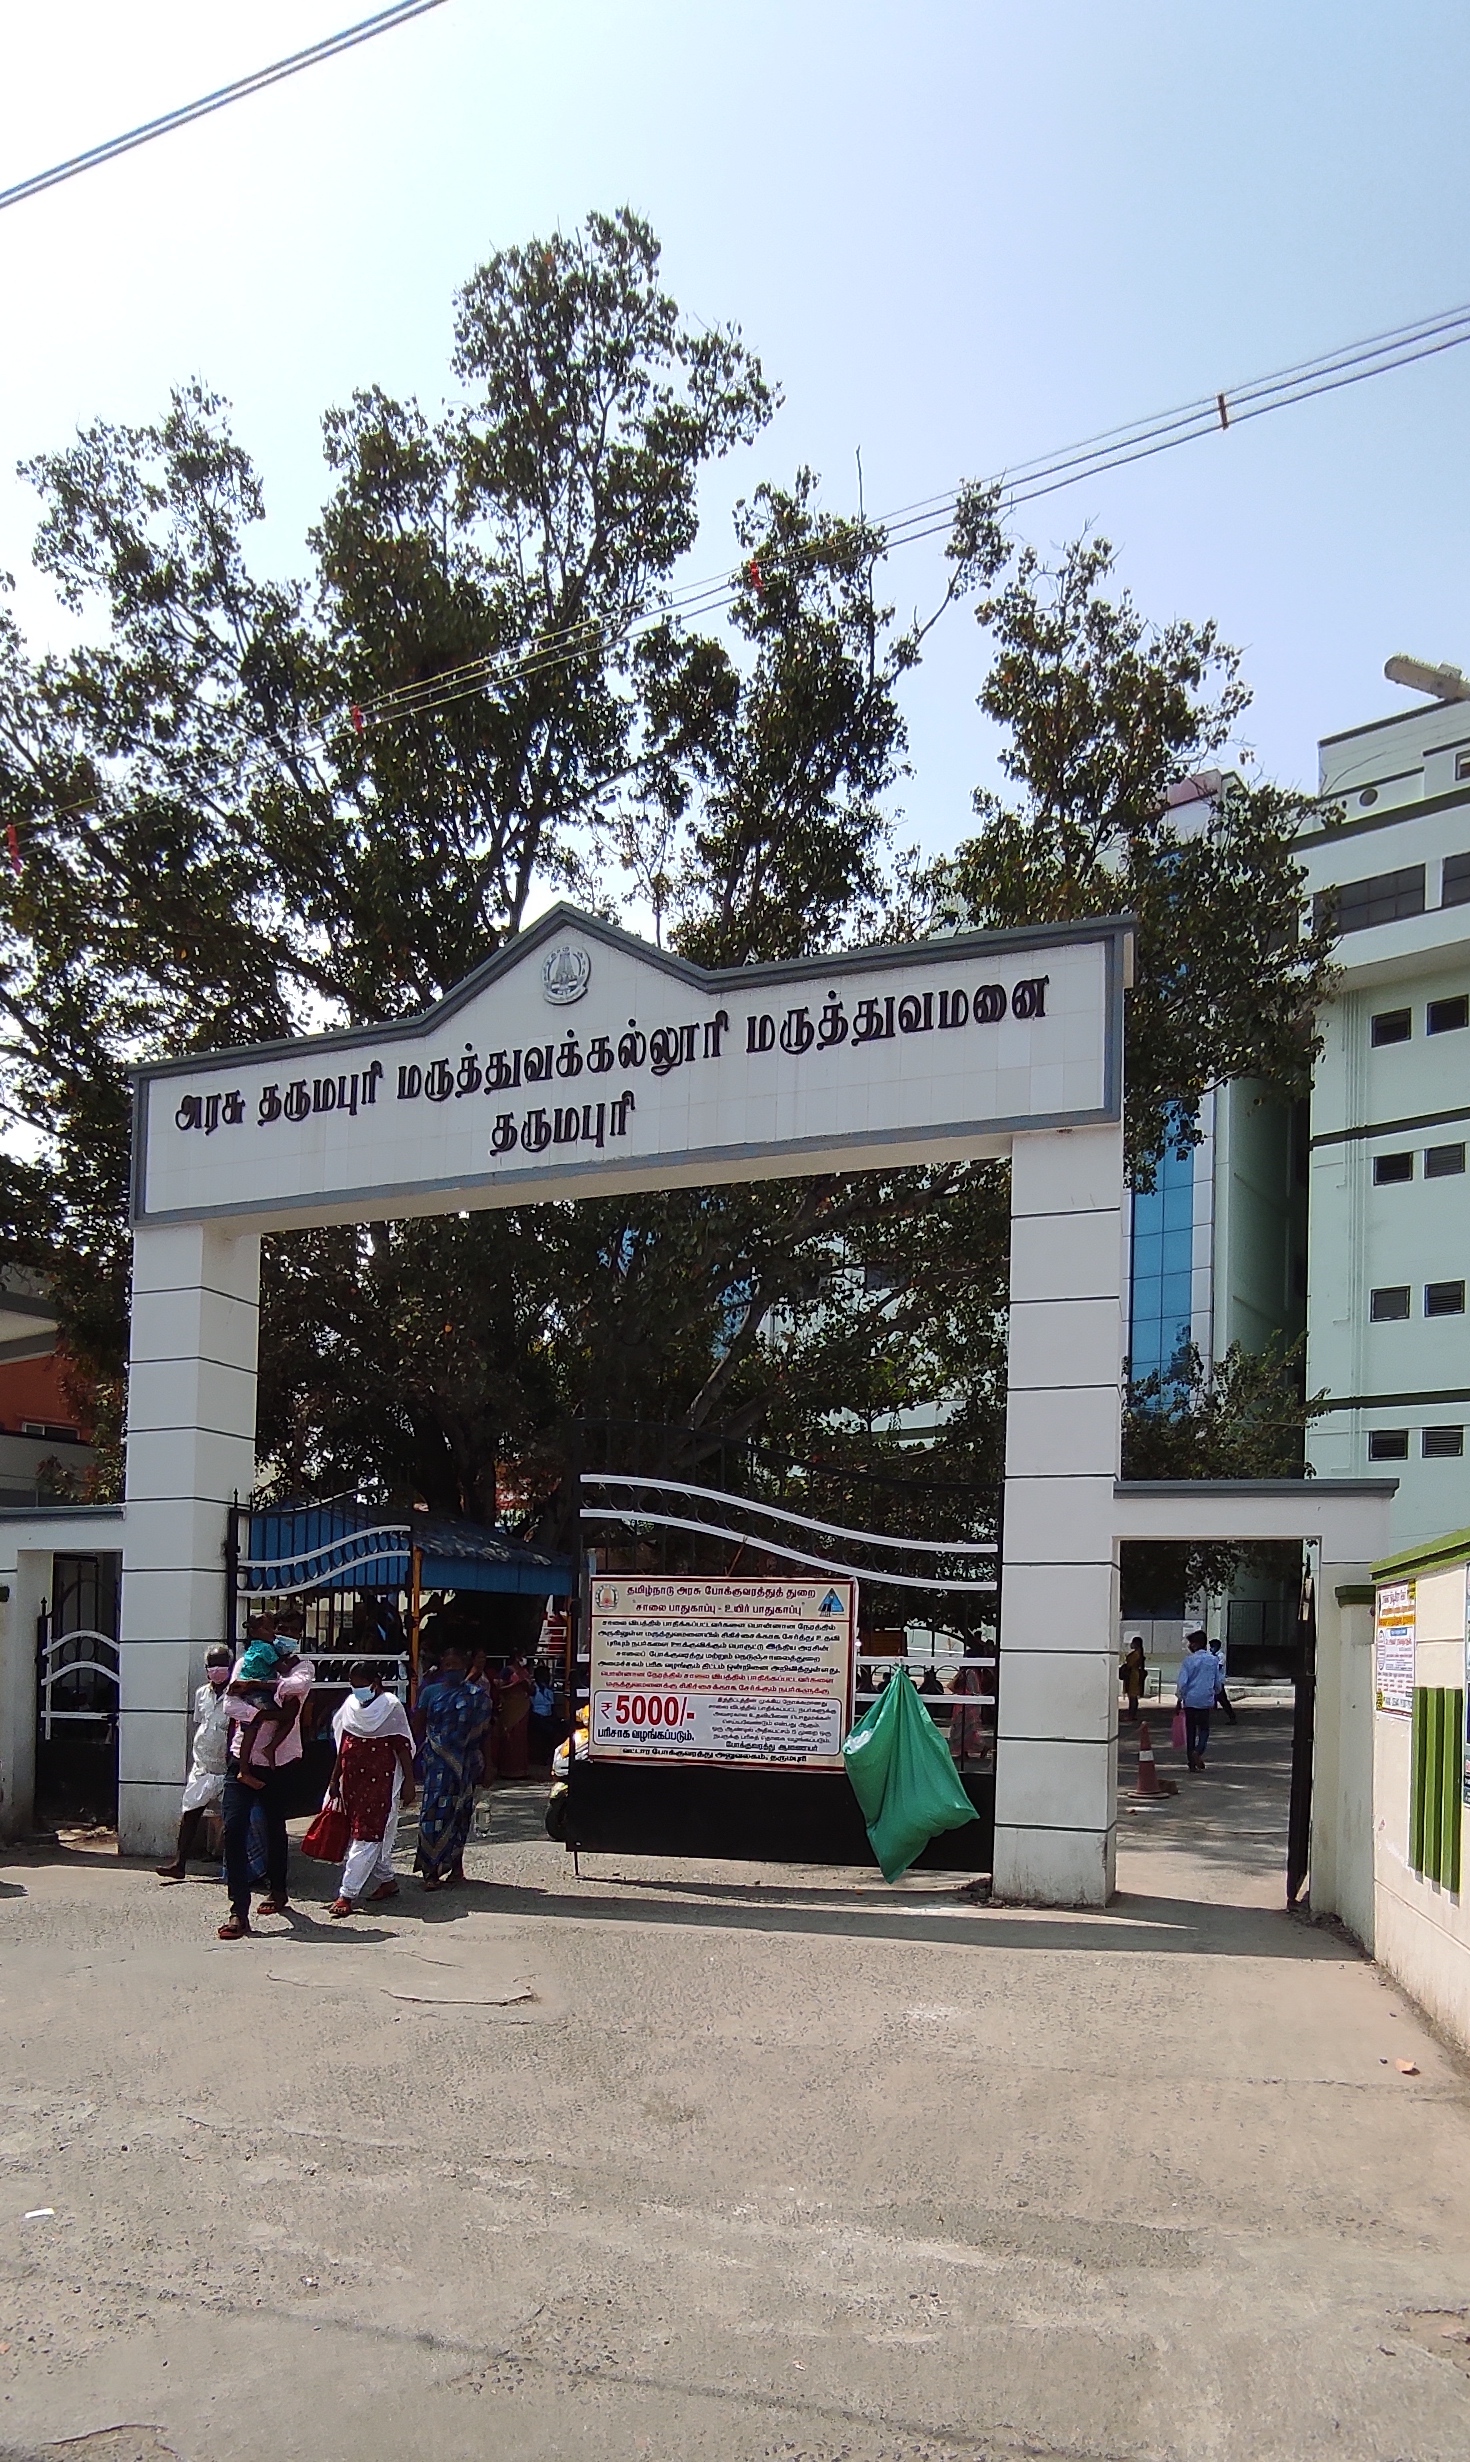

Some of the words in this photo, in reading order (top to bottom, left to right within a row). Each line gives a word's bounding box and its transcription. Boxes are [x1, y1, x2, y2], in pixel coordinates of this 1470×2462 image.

[175, 1089, 245, 1135] அரசு
[258, 1060, 383, 1126] தருமபுரி
[397, 1010, 728, 1100] மருத்துவக்கல்லூரி
[746, 975, 1050, 1056] மருத்துவமனை
[490, 1091, 636, 1155] தருமபுரி
[627, 1585, 674, 1596] தமிழ்நாடு
[676, 1587, 701, 1596] அரசு
[705, 1586, 783, 1599] போக்குவரத்துத்
[786, 1589, 816, 1599] துறை
[669, 1603, 716, 1615] பாதுகாப்பு
[598, 1727, 631, 1739] பரிசாக
